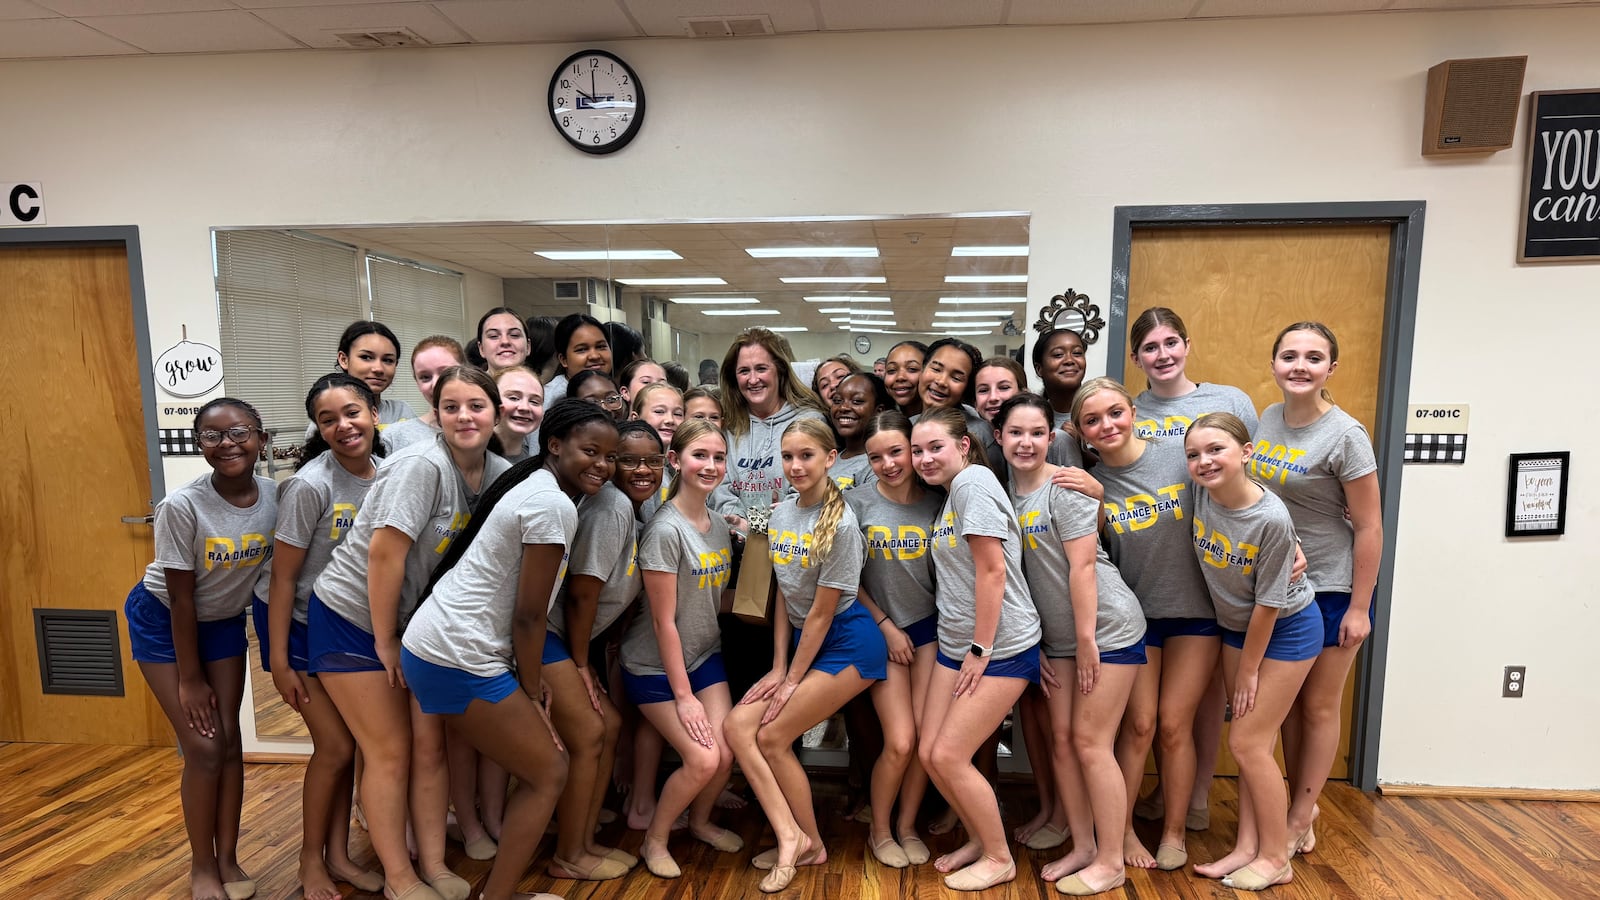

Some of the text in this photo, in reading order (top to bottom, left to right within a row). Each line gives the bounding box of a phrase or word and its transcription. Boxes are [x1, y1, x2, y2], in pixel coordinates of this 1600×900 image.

[589, 58, 599, 68] 12
[573, 64, 580, 74] 11
[560, 79, 569, 89] 10
[622, 75, 629, 85] 2
[557, 97, 565, 107] 9
[627, 94, 633, 103] 3
[562, 116, 570, 127] 8
[621, 113, 628, 123] 4
[576, 130, 583, 140] 7
[593, 133, 600, 144] 6
[610, 128, 617, 138] 5
[9, 184, 40, 222] C
[1533, 191, 1600, 223] can
[165, 356, 218, 387] grow
[1416, 409, 1461, 418] 07-001C
[1155, 426, 1186, 437] DANCE
[1255, 452, 1308, 475] DANCE TEAM
[1119, 506, 1151, 521] DANCE
[1152, 498, 1180, 514] TEAM
[1025, 524, 1048, 534] TEAM
[868, 525, 934, 561] RD
[870, 538, 931, 549] RAA DANCE TE
[205, 529, 276, 572] RD
[208, 551, 231, 561] RAA
[233, 546, 261, 560] DANCE
[771, 542, 808, 557] DANCE TEAM
[1199, 538, 1254, 566] DANCE TEAM
